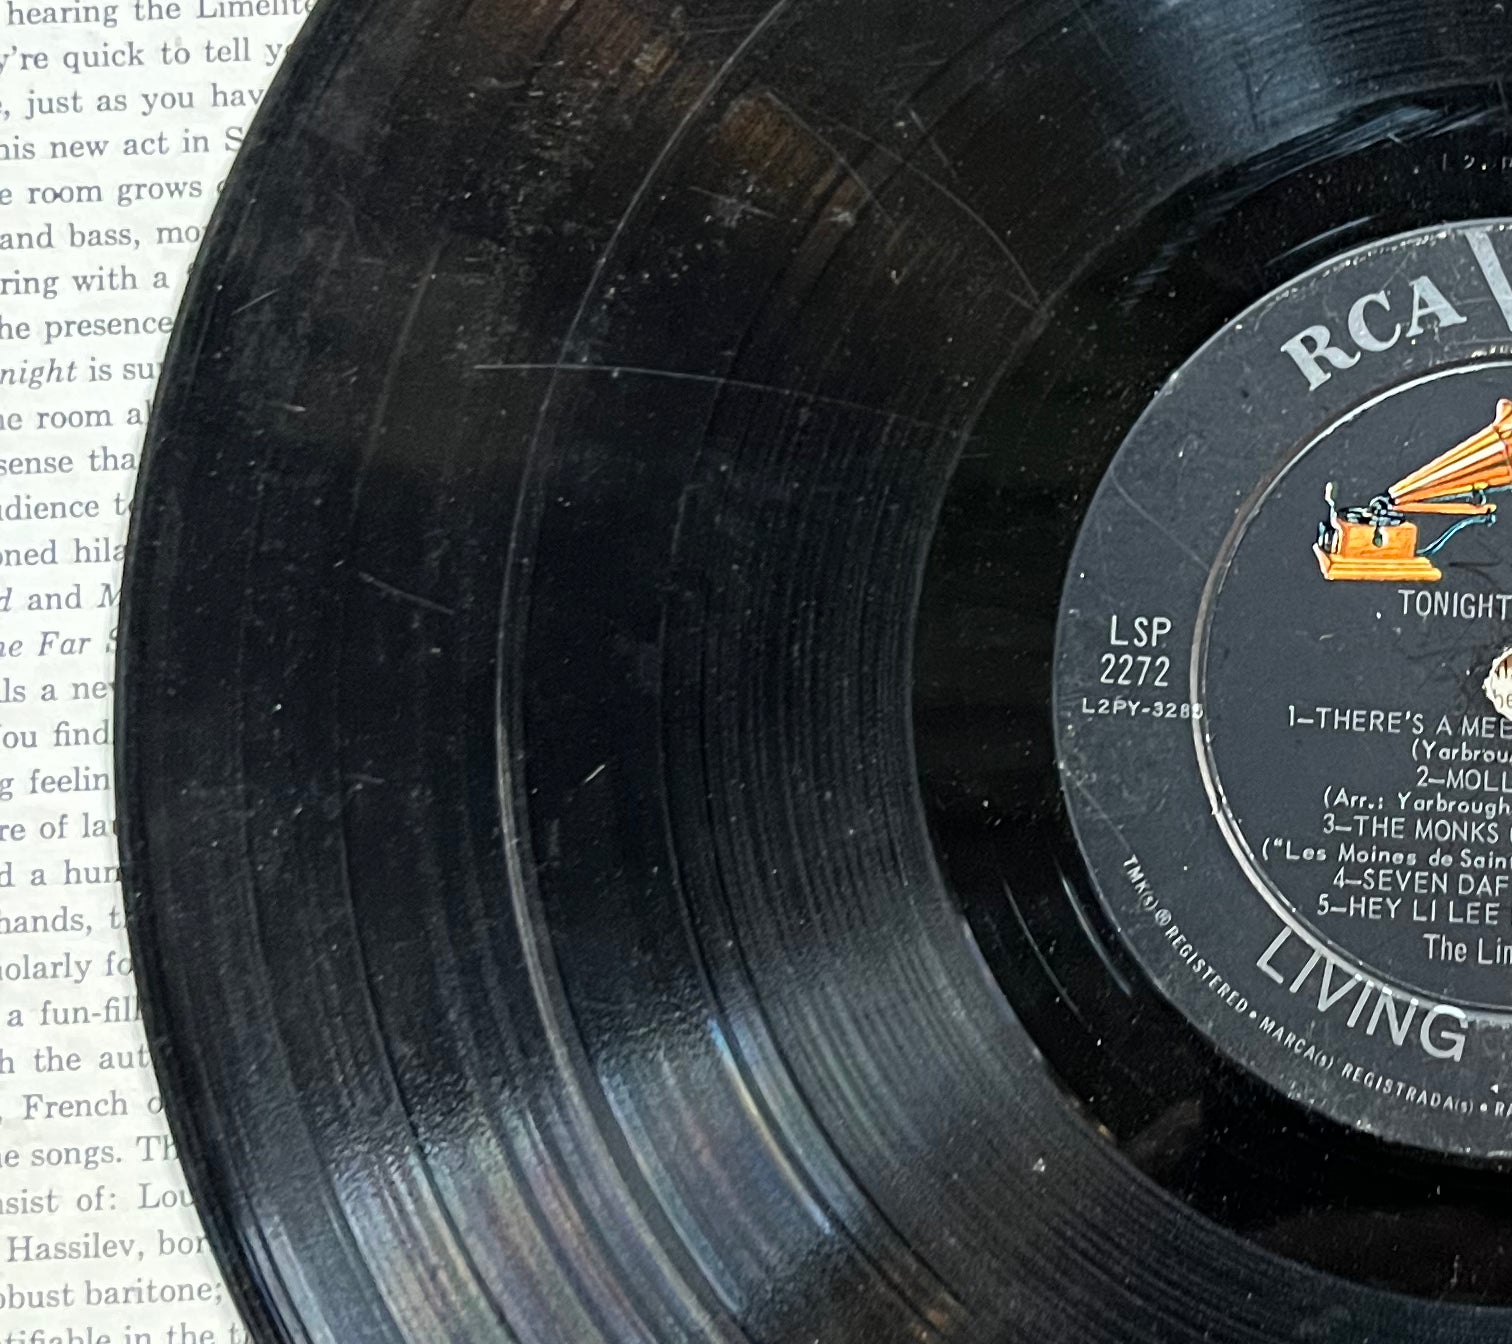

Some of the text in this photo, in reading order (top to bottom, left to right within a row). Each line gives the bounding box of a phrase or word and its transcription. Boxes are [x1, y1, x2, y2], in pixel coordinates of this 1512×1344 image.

[62, 40, 145, 75] quick
[160, 41, 191, 66] to
[204, 36, 251, 63] tell
[24, 88, 84, 121] just
[96, 94, 128, 113] as
[140, 91, 195, 117] you
[210, 82, 265, 108] hav
[49, 140, 110, 159] new
[122, 131, 170, 156] act
[182, 127, 210, 154] in
[27, 184, 104, 205] room
[117, 180, 203, 208] grows
[0, 222, 140, 251] and bass,
[71, 264, 139, 292] with
[152, 271, 170, 289] a
[44, 312, 175, 346] presence
[1281, 275, 1467, 392] RCA
[88, 356, 113, 383] is
[36, 409, 114, 430] room
[89, 444, 138, 472] tha
[27, 583, 82, 611] and
[37, 630, 92, 657] Far
[1110, 614, 1172, 647] LSP
[1100, 654, 1170, 686] 2272
[40, 683, 58, 702] a
[1436, 716, 1452, 737] A
[29, 765, 112, 795] feelin
[39, 813, 69, 840] of
[1415, 819, 1501, 844] MONKS
[1338, 844, 1418, 866] Moines
[1428, 848, 1454, 867] de
[30, 868, 48, 887] a
[1413, 899, 1438, 923] LI
[1448, 902, 1501, 925] LEE
[1423, 933, 1467, 964] The
[0, 951, 93, 985] olarly
[1165, 925, 1248, 1013] REGISTERED
[1256, 925, 1469, 1062] LIVING
[6, 1009, 24, 1028] a
[33, 1045, 82, 1073] the
[21, 1089, 129, 1121] French
[31, 1145, 122, 1171] songs.
[0, 1188, 59, 1215] sist
[76, 1184, 116, 1212] of:
[6, 1228, 211, 1263] Hassilev, bor
[84, 1277, 223, 1306] baritone;
